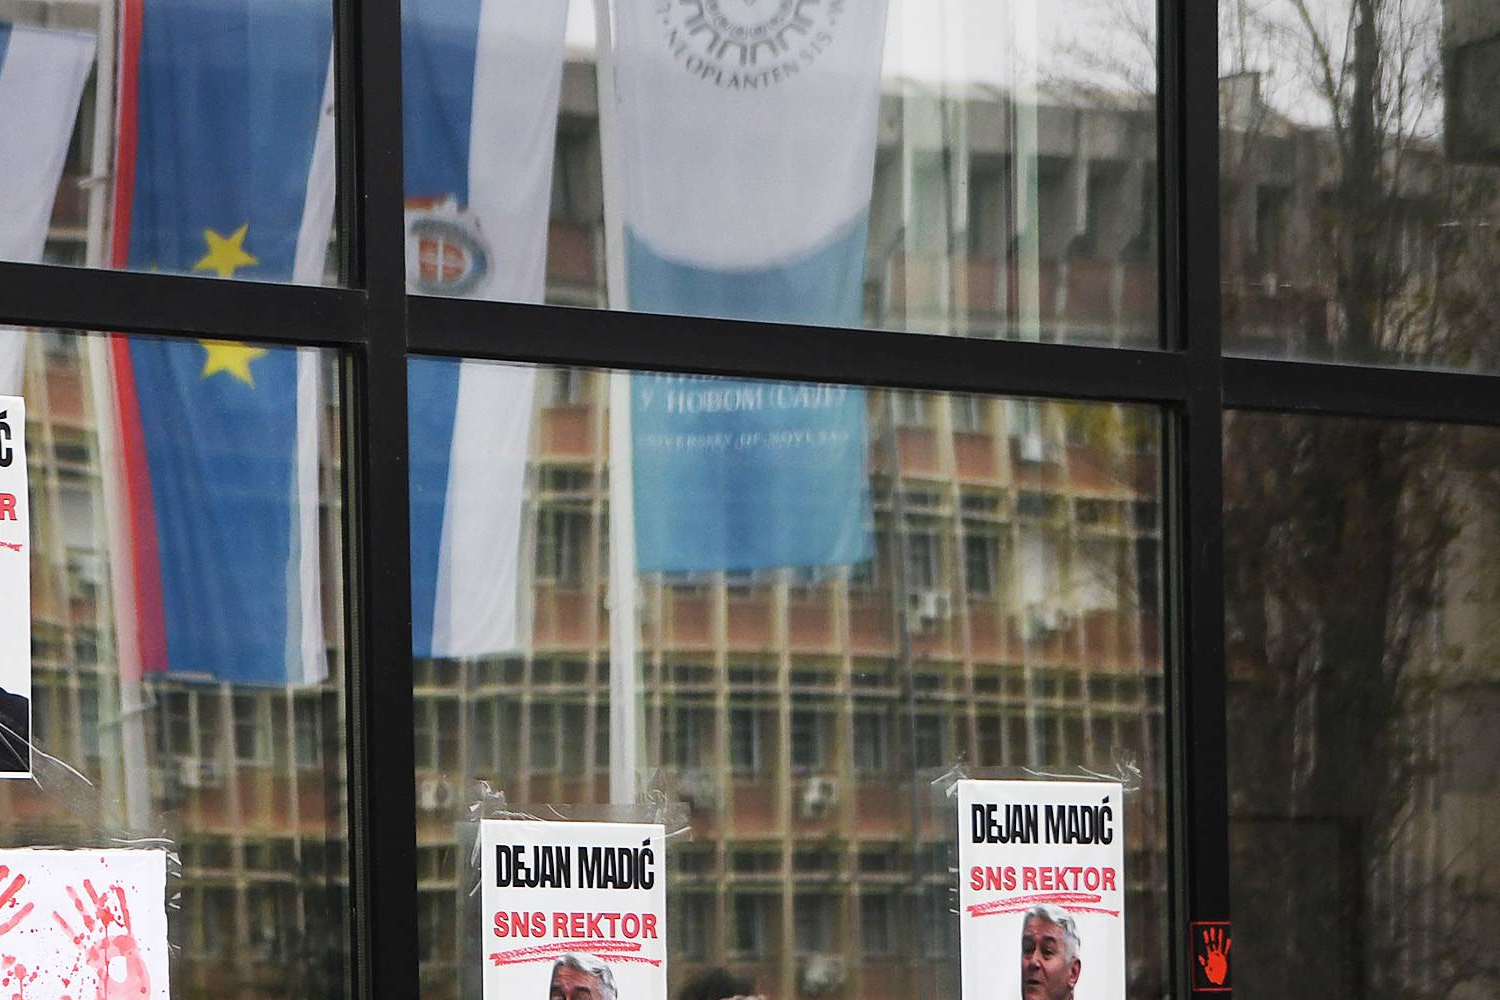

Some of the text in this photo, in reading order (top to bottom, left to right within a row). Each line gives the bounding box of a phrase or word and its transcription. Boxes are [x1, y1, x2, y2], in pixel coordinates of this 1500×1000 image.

[971, 795, 1113, 845] DEJAN MADIĆ
[495, 837, 655, 890] DEJAN MADIĆ
[970, 866, 1116, 891] SNS REKTOR
[493, 911, 658, 939] SNS REKTOR
